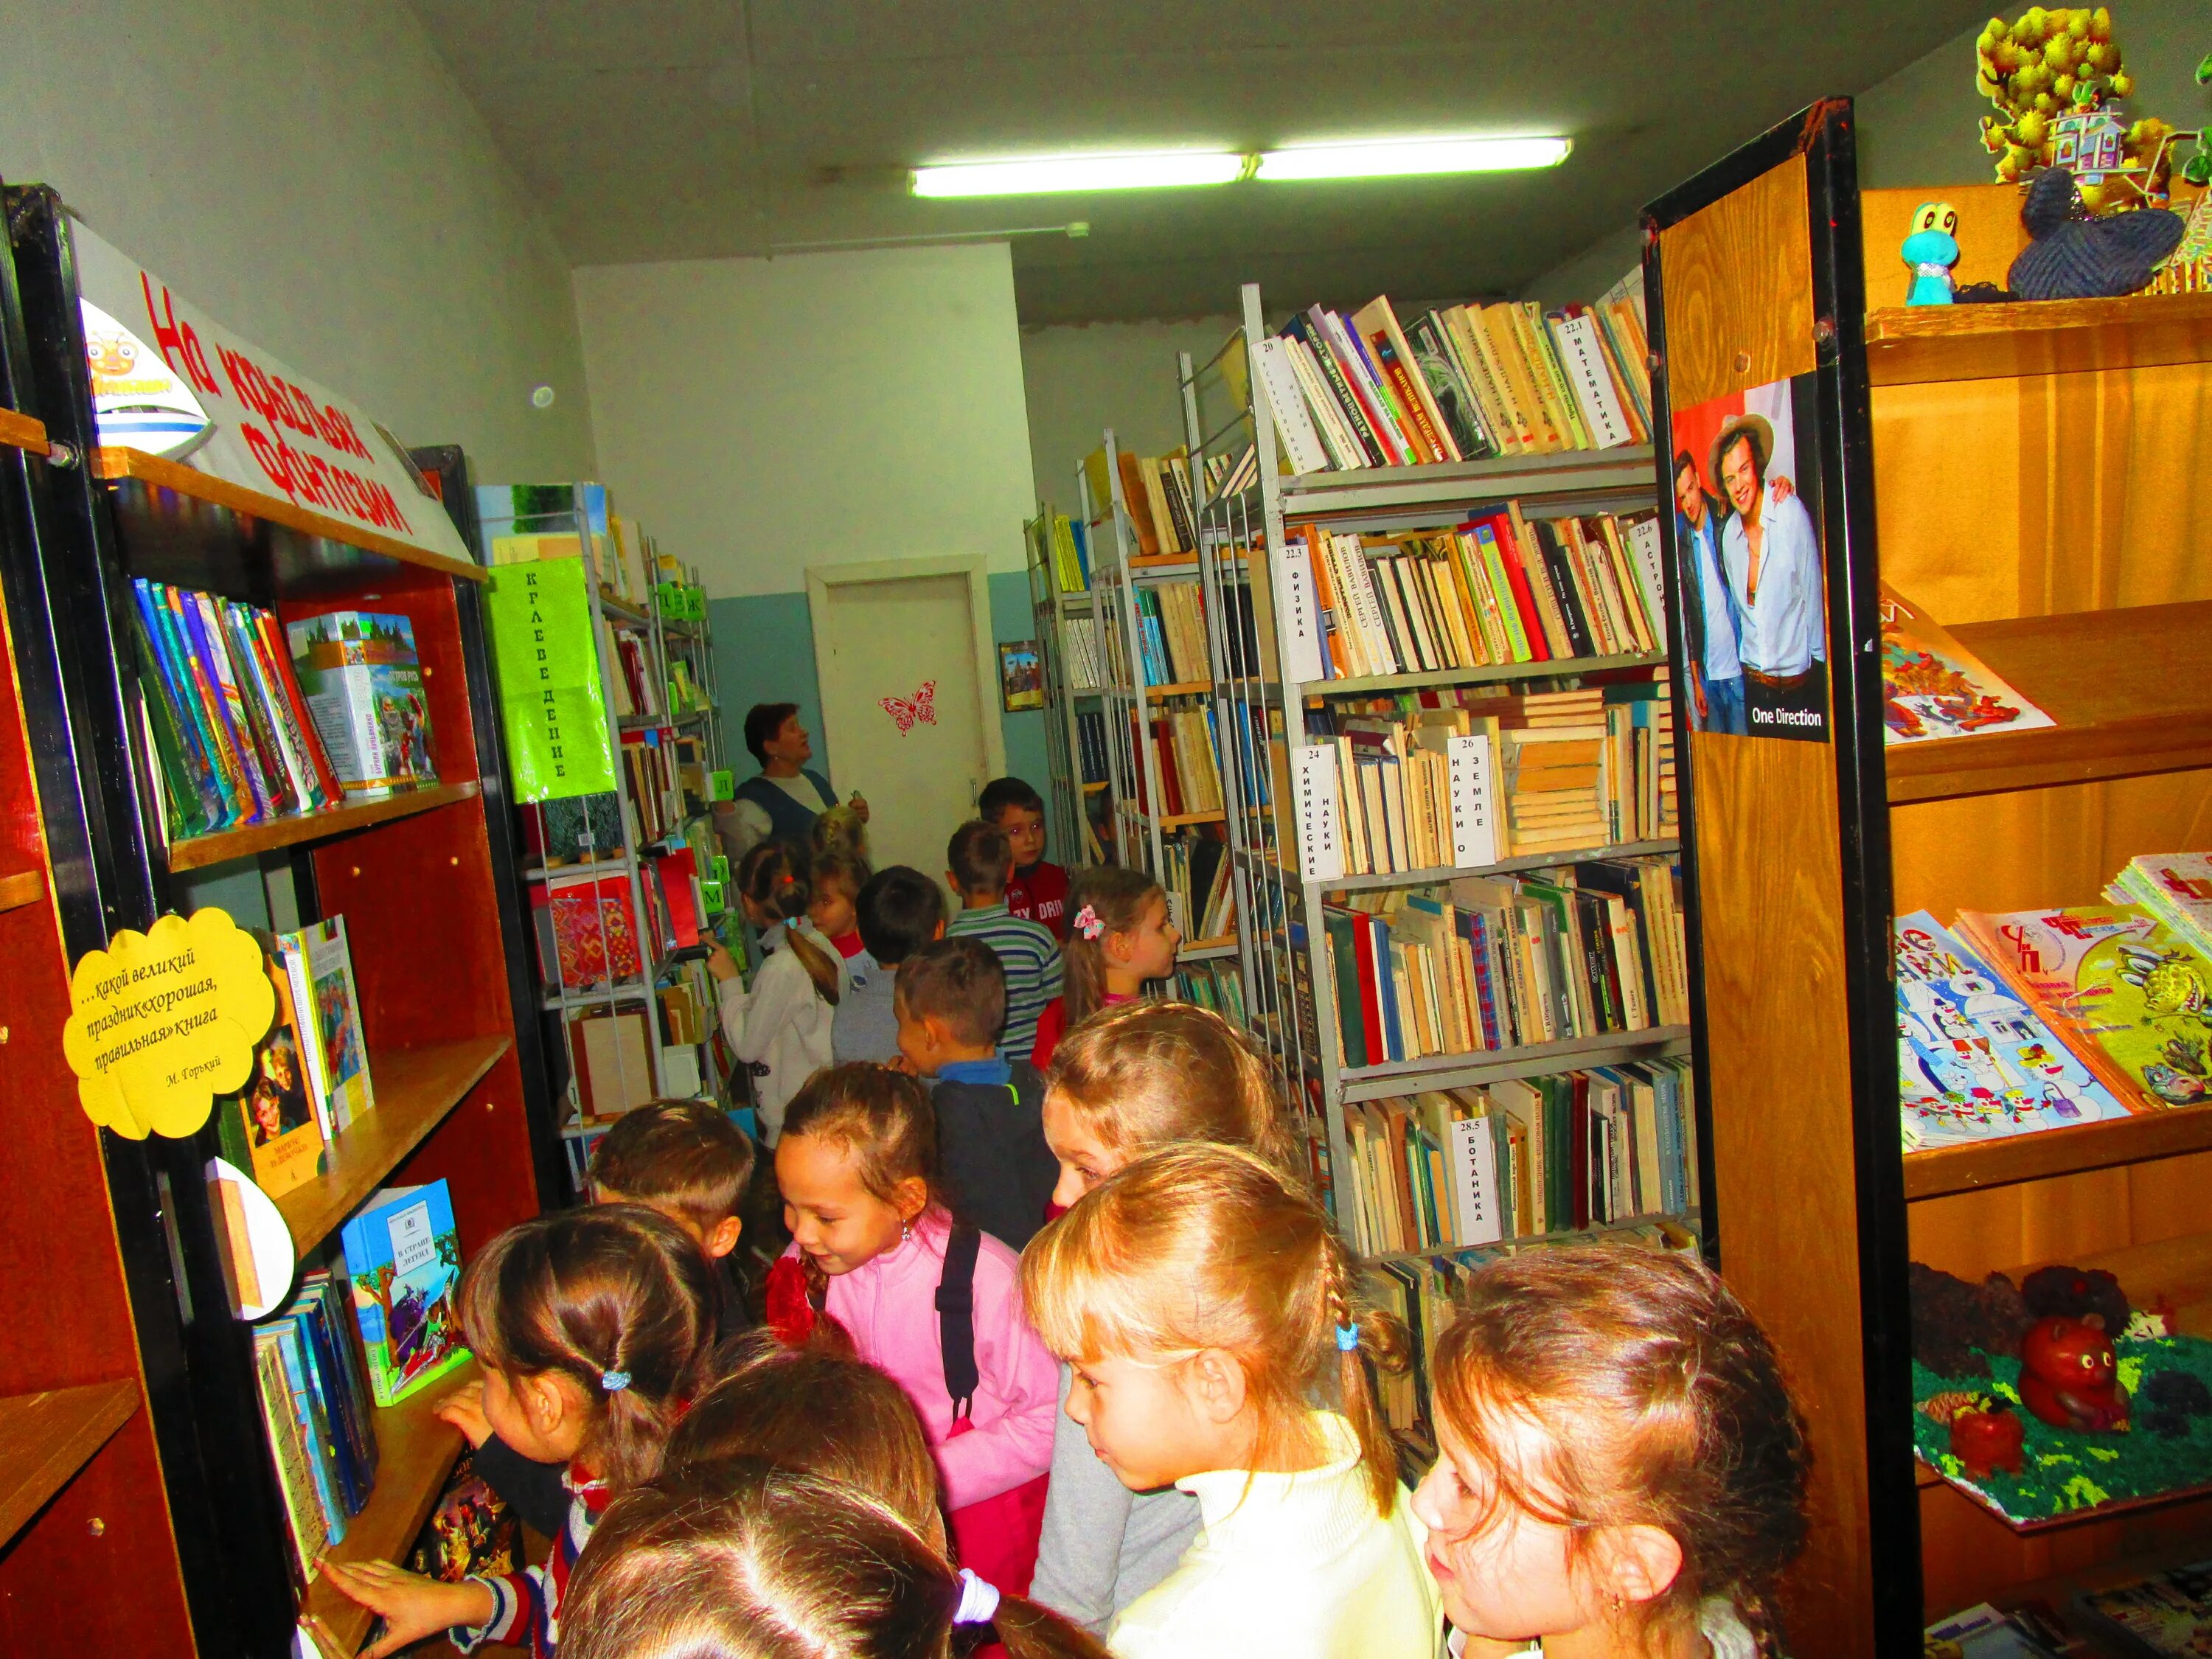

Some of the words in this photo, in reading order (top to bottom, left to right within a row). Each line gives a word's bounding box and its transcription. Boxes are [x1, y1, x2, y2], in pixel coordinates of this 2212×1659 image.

[1565, 321, 1582, 335] 22.1
[1264, 343, 1273, 353] 20
[141, 270, 222, 398] На
[215, 341, 375, 464] крыльях
[1573, 337, 1616, 441] МАТЕМАТИКА
[240, 421, 413, 536] фантазии
[1636, 524, 1653, 537] 22.6
[1286, 548, 1302, 559] 22.3
[1339, 546, 1357, 589] ВАВИЛОВ
[1352, 544, 1371, 588] ВАВИЛОВ
[1292, 571, 1304, 638] ФИЗИКА
[1352, 592, 1368, 628] СЕРГЕЙ
[1364, 591, 1382, 627] СЕРГЕЙ
[1752, 707, 1774, 723] One
[1776, 707, 1822, 726] Direction
[1309, 750, 1320, 759] 24
[1462, 739, 1474, 748] 26
[1452, 759, 1464, 829] НАУКИ
[1472, 757, 1484, 827] ЗЕМЛЕ
[1302, 766, 1315, 875] ХИМИЧЕСКИЕ
[1322, 798, 1331, 851] НАУКИ
[1458, 844, 1466, 852] О
[704, 889, 720, 904] М
[132, 947, 196, 984] великий
[165, 1073, 180, 1088] М.
[181, 1055, 222, 1081] Горький
[1460, 1121, 1480, 1132] 28.5
[1468, 1136, 1483, 1221] БОТАНИКА
[405, 1236, 431, 1254] СТРАНЕ
